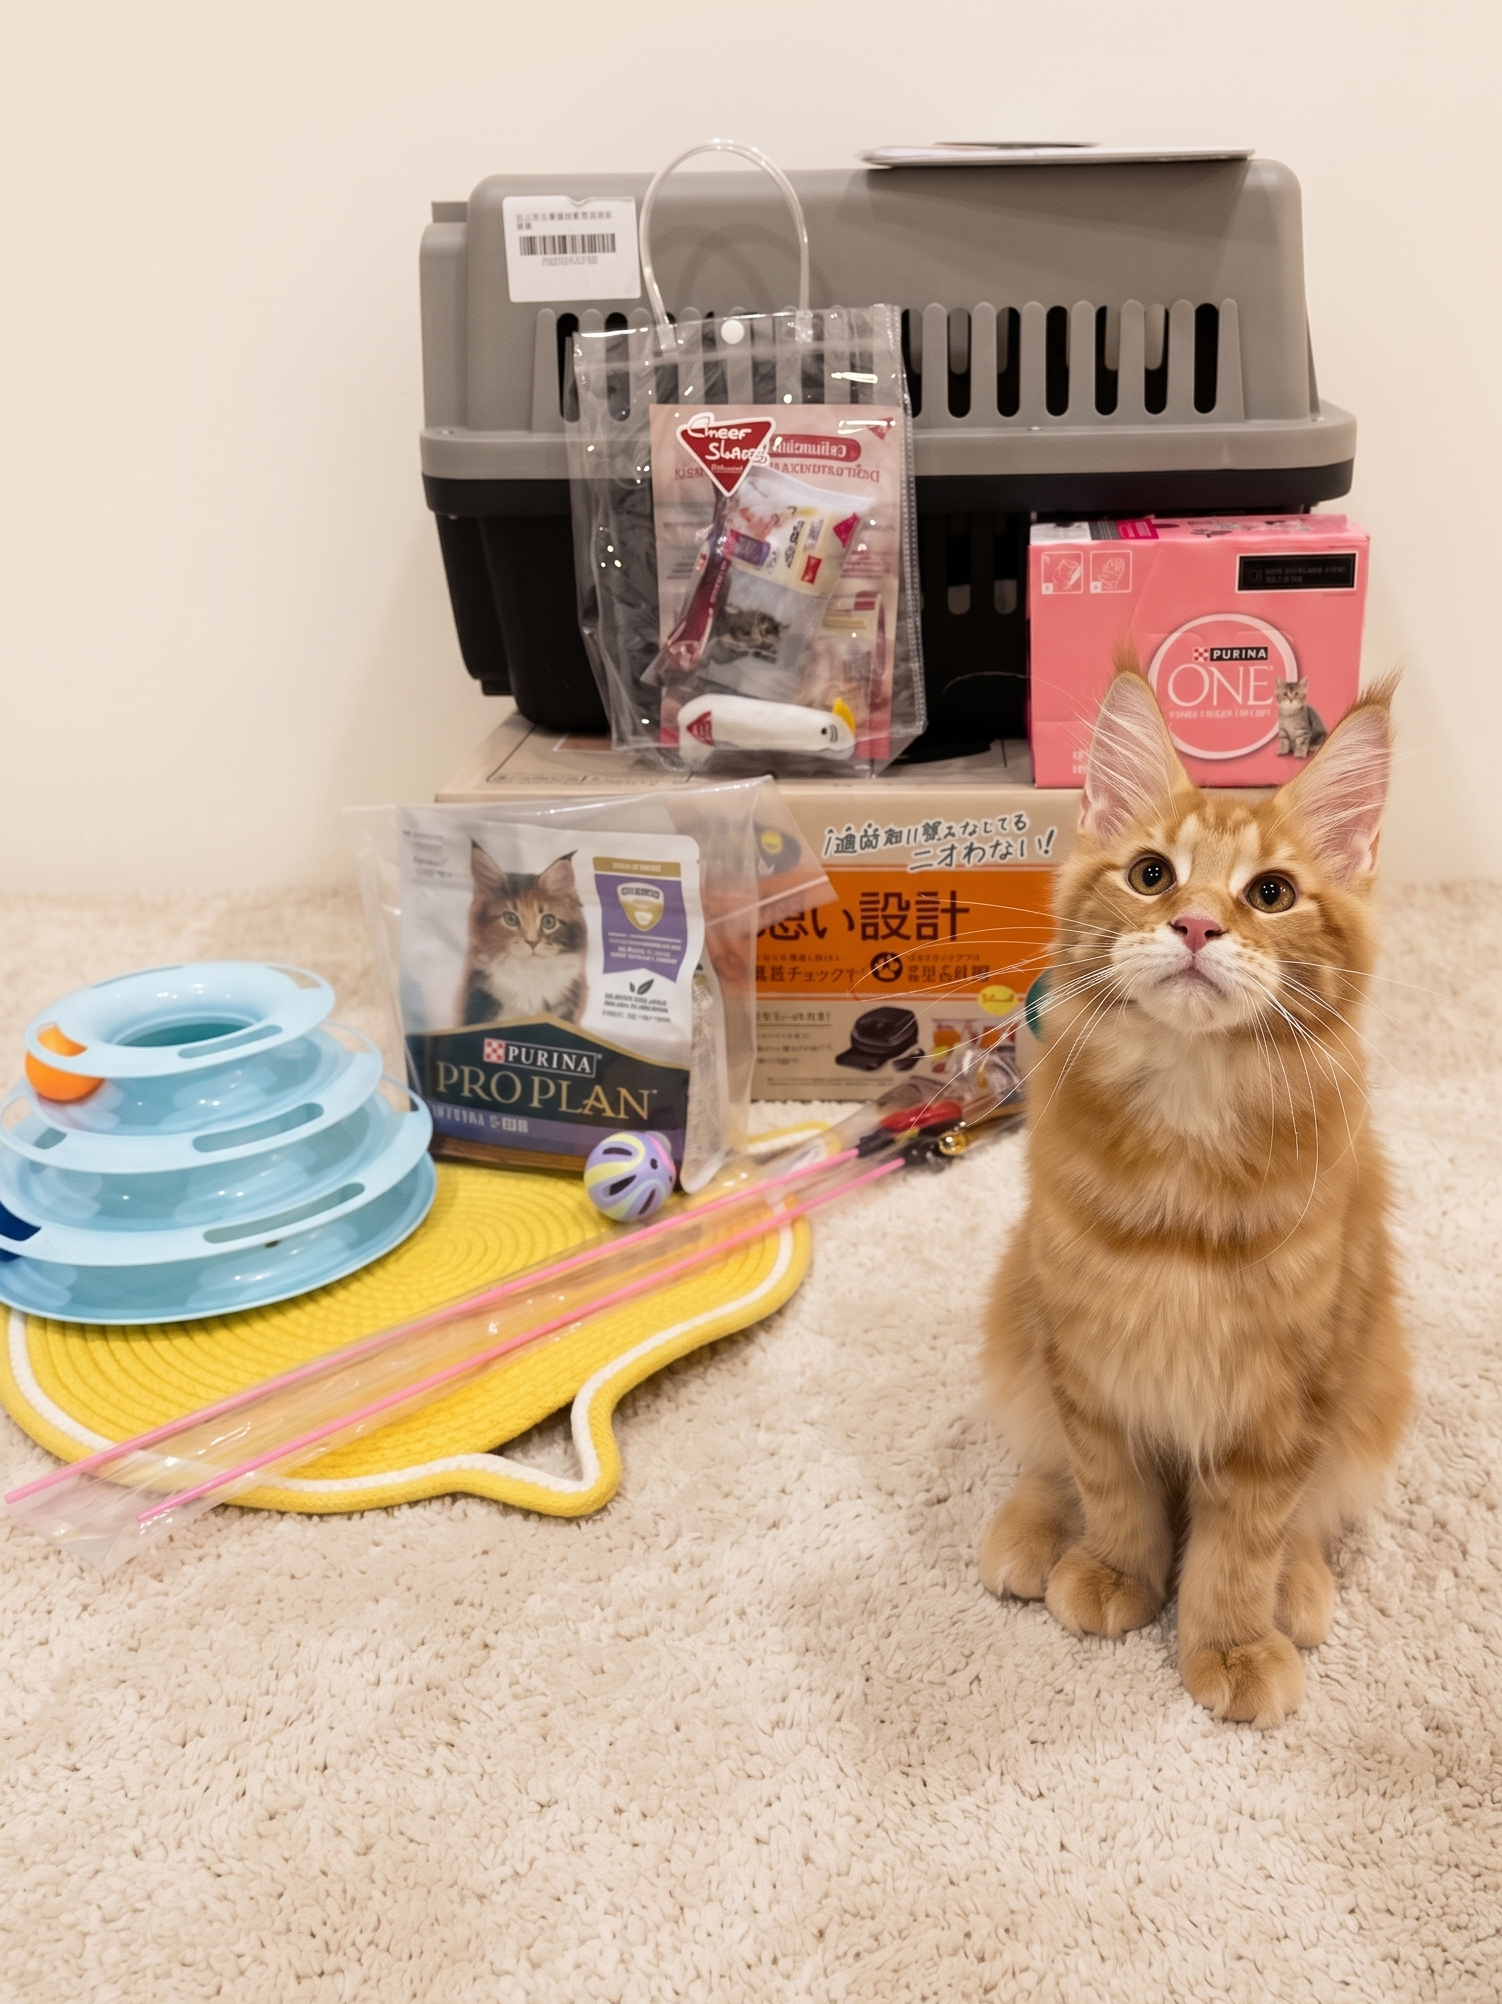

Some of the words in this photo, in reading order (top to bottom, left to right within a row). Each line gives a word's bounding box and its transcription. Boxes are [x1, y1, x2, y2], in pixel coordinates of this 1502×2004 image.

[1212, 648, 1267, 660] PURINA
[1167, 663, 1274, 707] ONE
[507, 1044, 593, 1074] PURINA
[435, 1060, 522, 1104] PRO
[530, 1075, 651, 1121] PLAN
